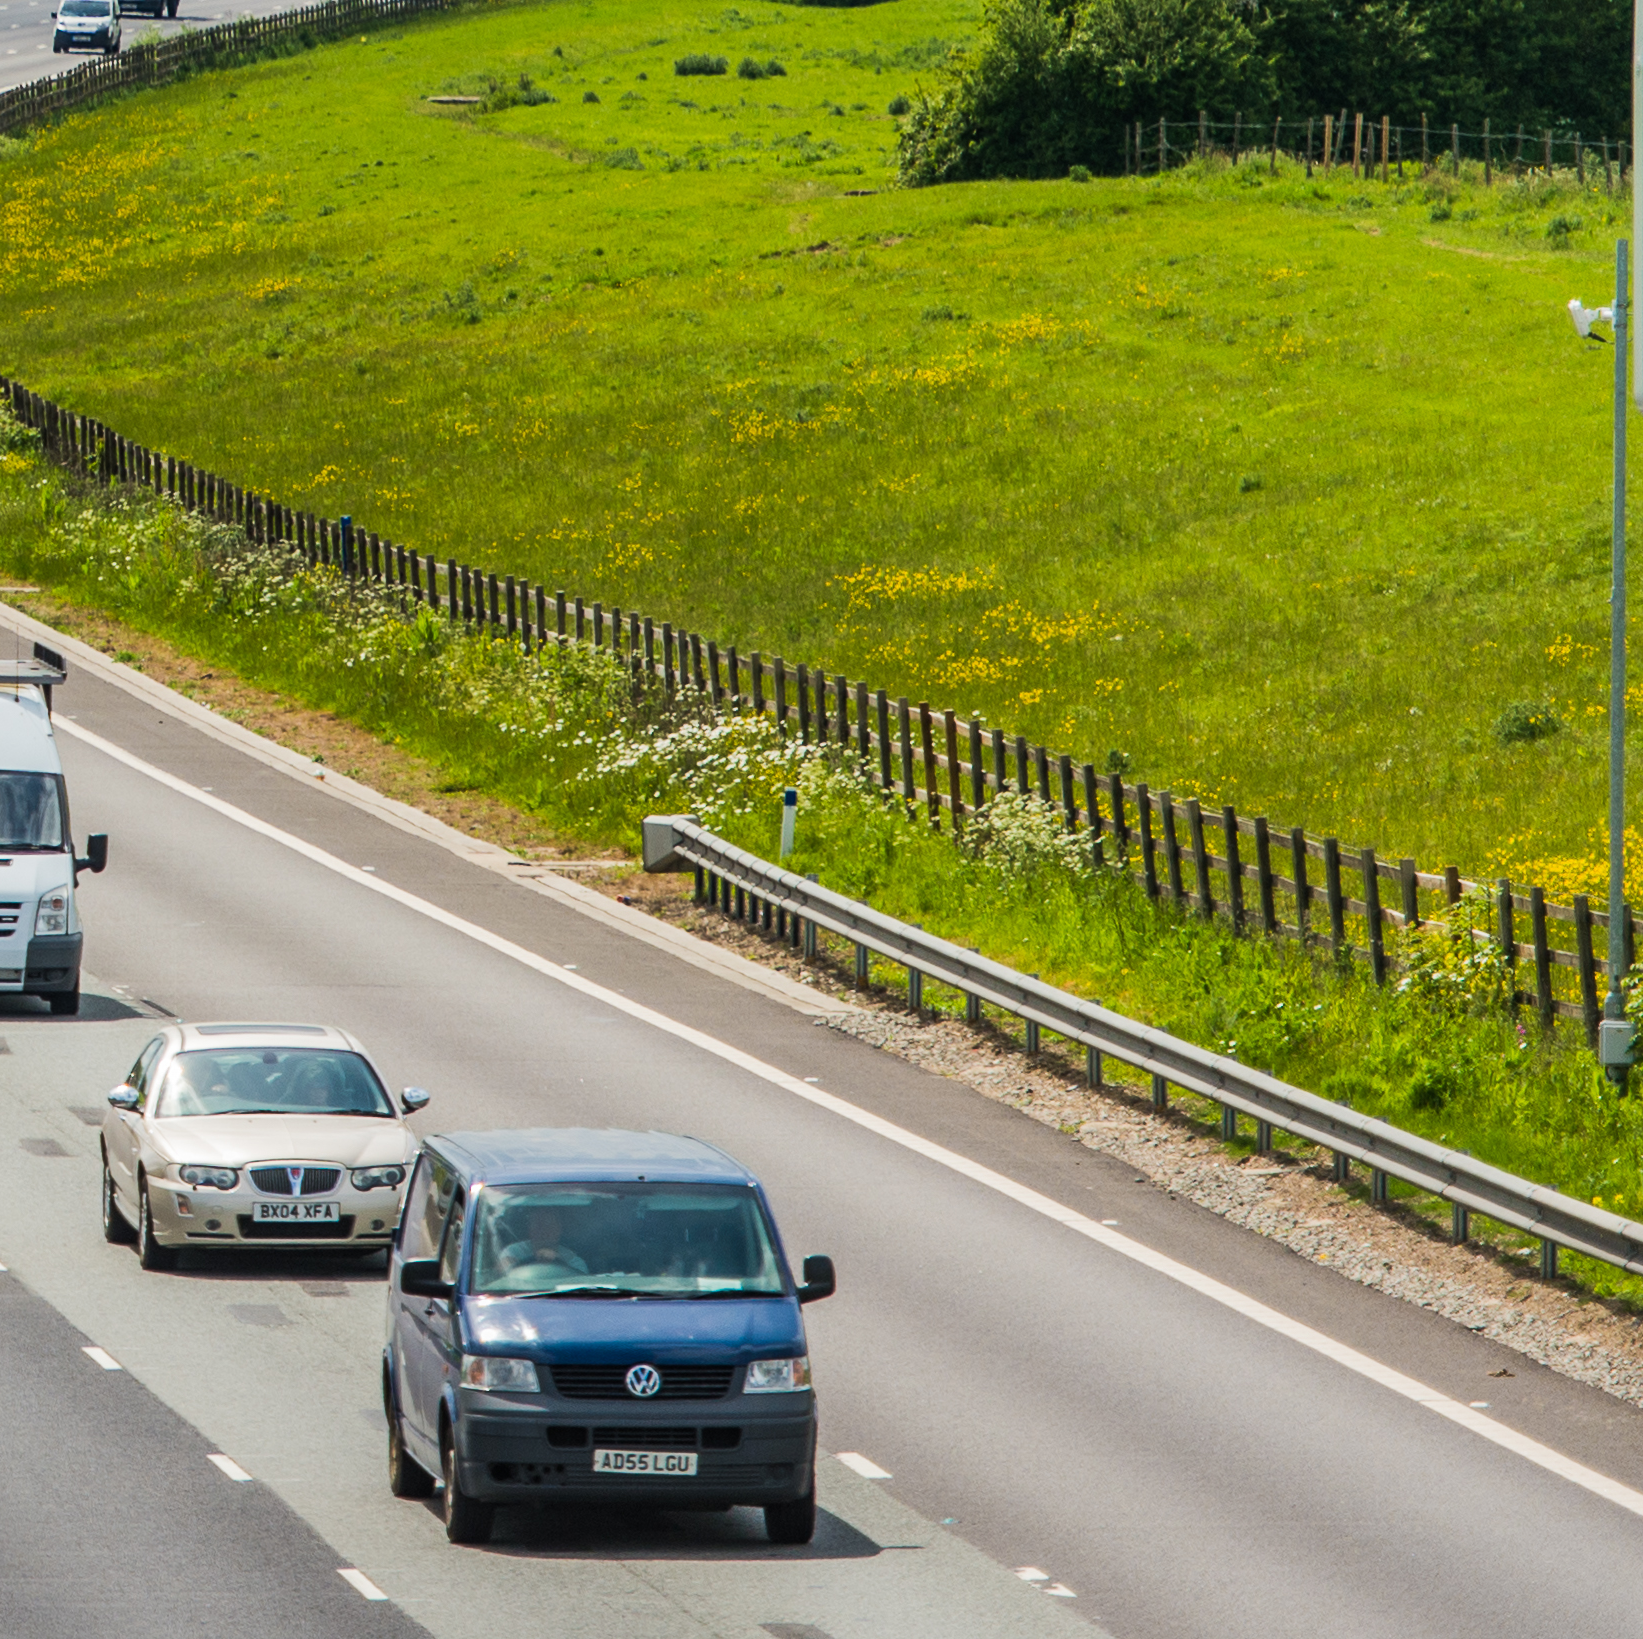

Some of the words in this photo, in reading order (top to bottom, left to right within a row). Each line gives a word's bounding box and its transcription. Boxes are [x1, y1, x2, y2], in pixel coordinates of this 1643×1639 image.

[260, 1204, 299, 1218] BX04
[303, 1205, 333, 1218] XFA
[602, 1453, 649, 1470] AD55
[653, 1455, 690, 1472] LGU
